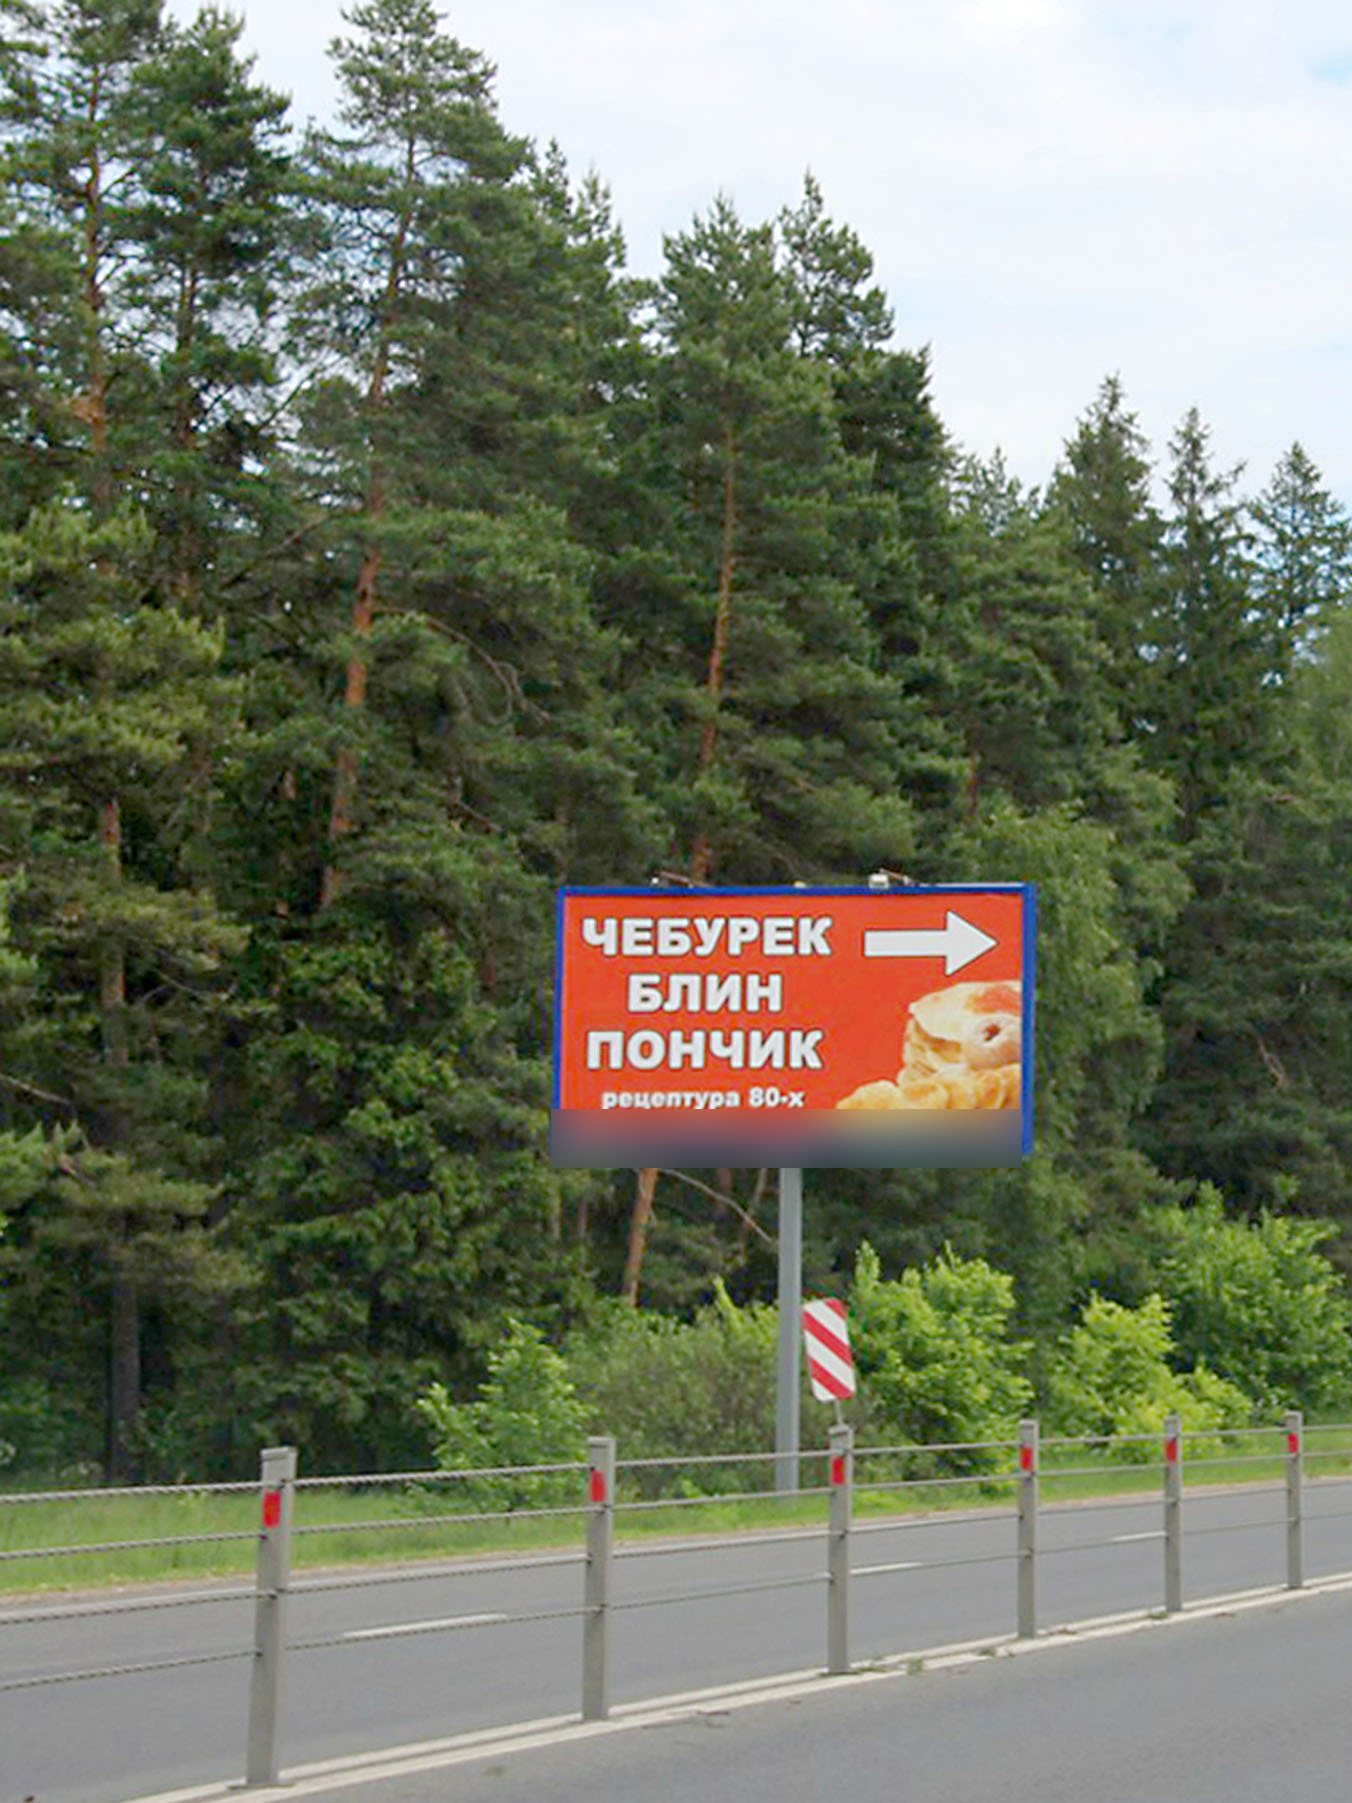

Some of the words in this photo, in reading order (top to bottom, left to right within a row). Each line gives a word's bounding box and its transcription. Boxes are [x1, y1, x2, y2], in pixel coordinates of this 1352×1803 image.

[582, 917, 833, 957] ЧЕБУРЕК
[628, 974, 783, 1013] БЛИН
[587, 1030, 823, 1070] ПОНЧИК
[601, 1091, 741, 1110] рецептура
[748, 1086, 805, 1108] 80-х
